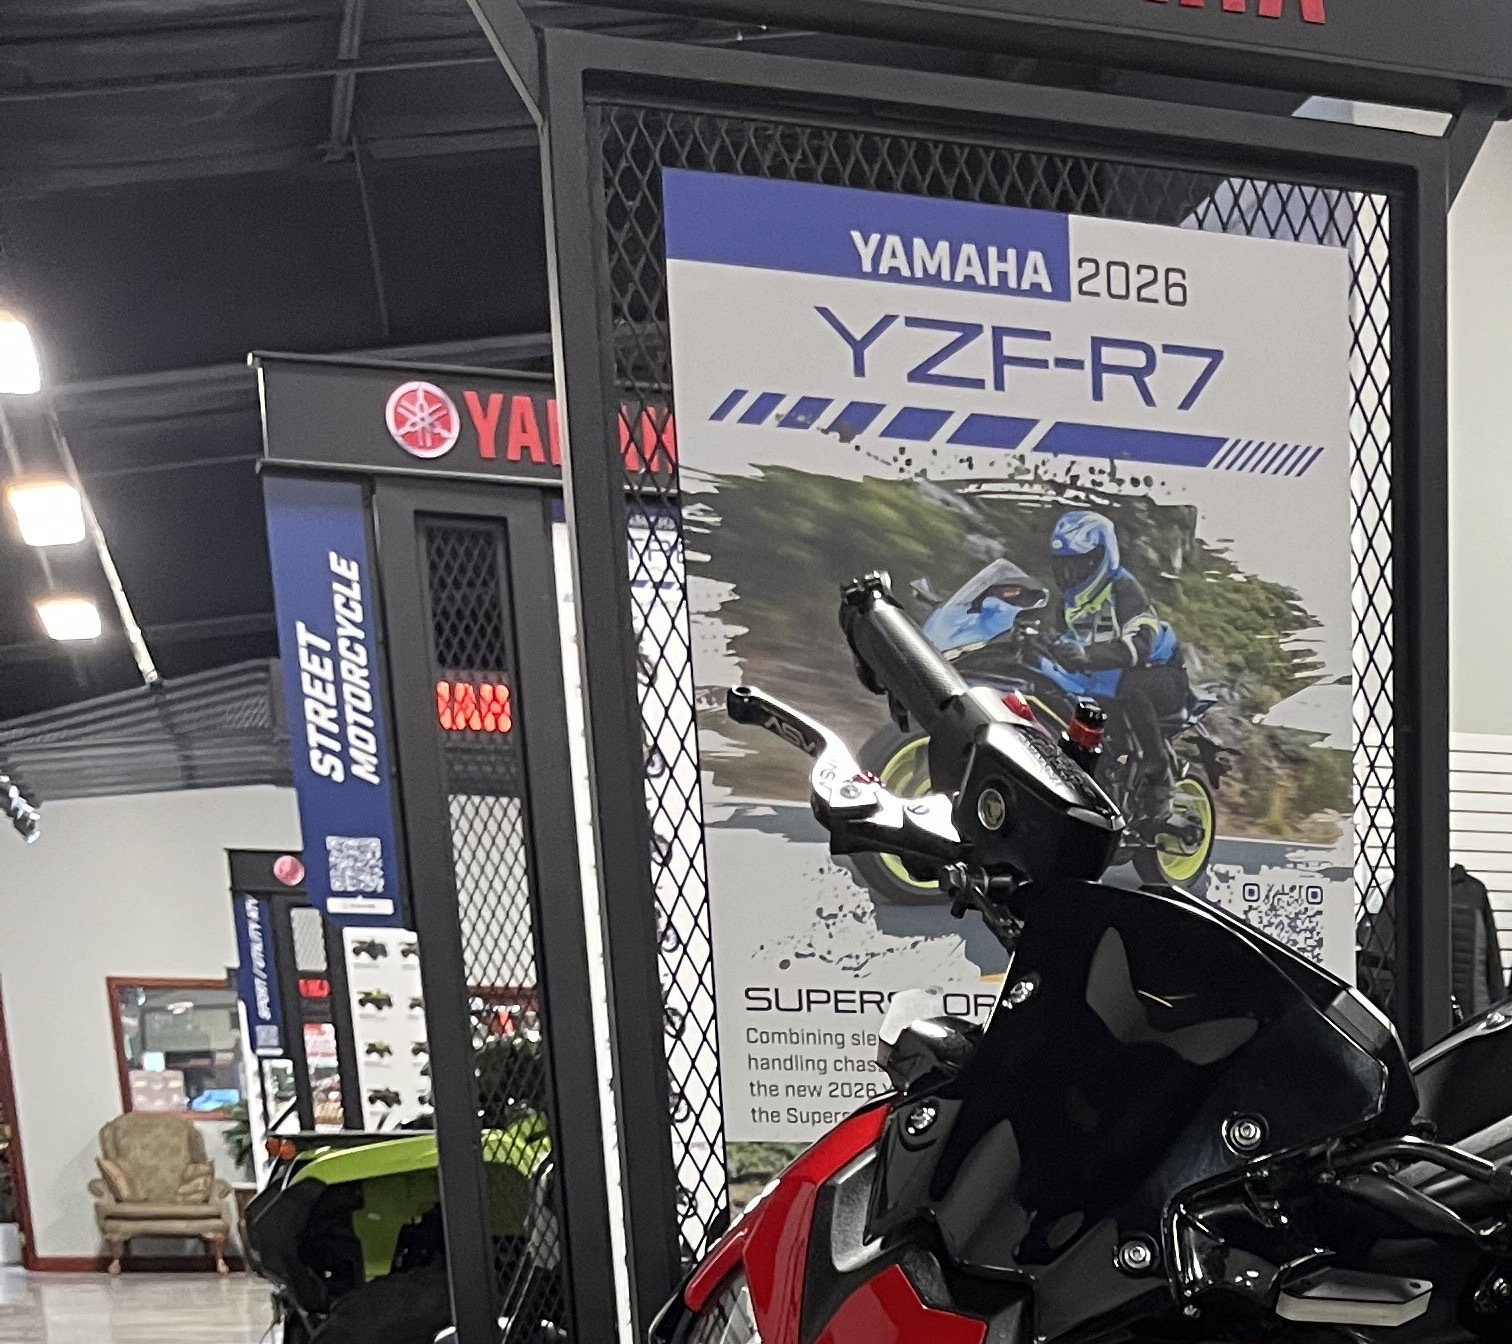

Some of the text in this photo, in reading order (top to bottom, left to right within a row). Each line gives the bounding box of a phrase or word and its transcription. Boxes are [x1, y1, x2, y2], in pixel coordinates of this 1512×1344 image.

[850, 229, 1188, 307] YAMAHA 2026
[813, 305, 1225, 411] YZF-R7
[328, 550, 380, 786] MOTORCYCLE
[295, 619, 345, 783] STREET
[744, 987, 998, 1017] SUPEROR
[746, 1027, 845, 1049] Combining
[747, 1054, 828, 1075] handling
[749, 1080, 779, 1098] the
[785, 1084, 823, 1098] new
[828, 1082, 877, 1099] 2026
[751, 1107, 780, 1123] the
